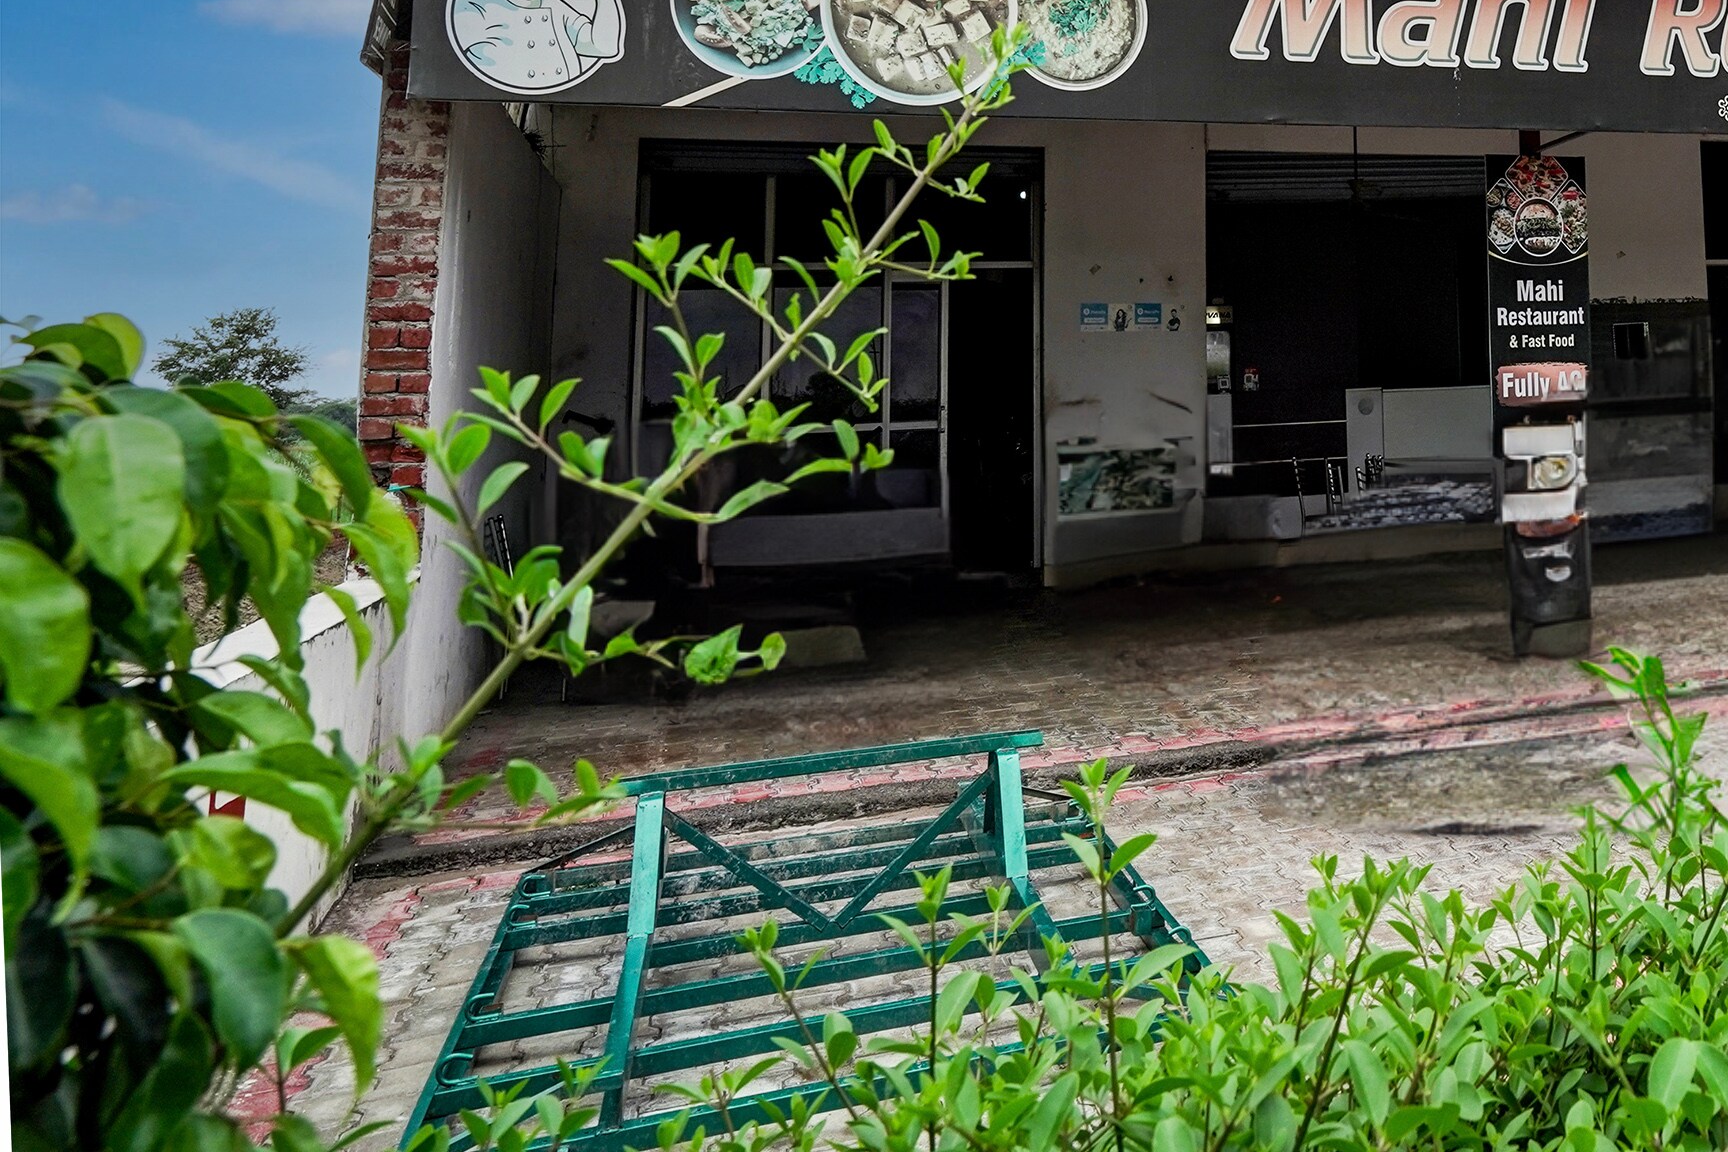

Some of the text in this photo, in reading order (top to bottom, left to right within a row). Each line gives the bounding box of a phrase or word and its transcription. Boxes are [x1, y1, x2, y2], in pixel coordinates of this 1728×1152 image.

[1516, 279, 1564, 302] Mahi
[1497, 306, 1585, 326] Restaurant
[1509, 333, 1575, 349] & Fast Food
[1502, 372, 1550, 401] Fully
